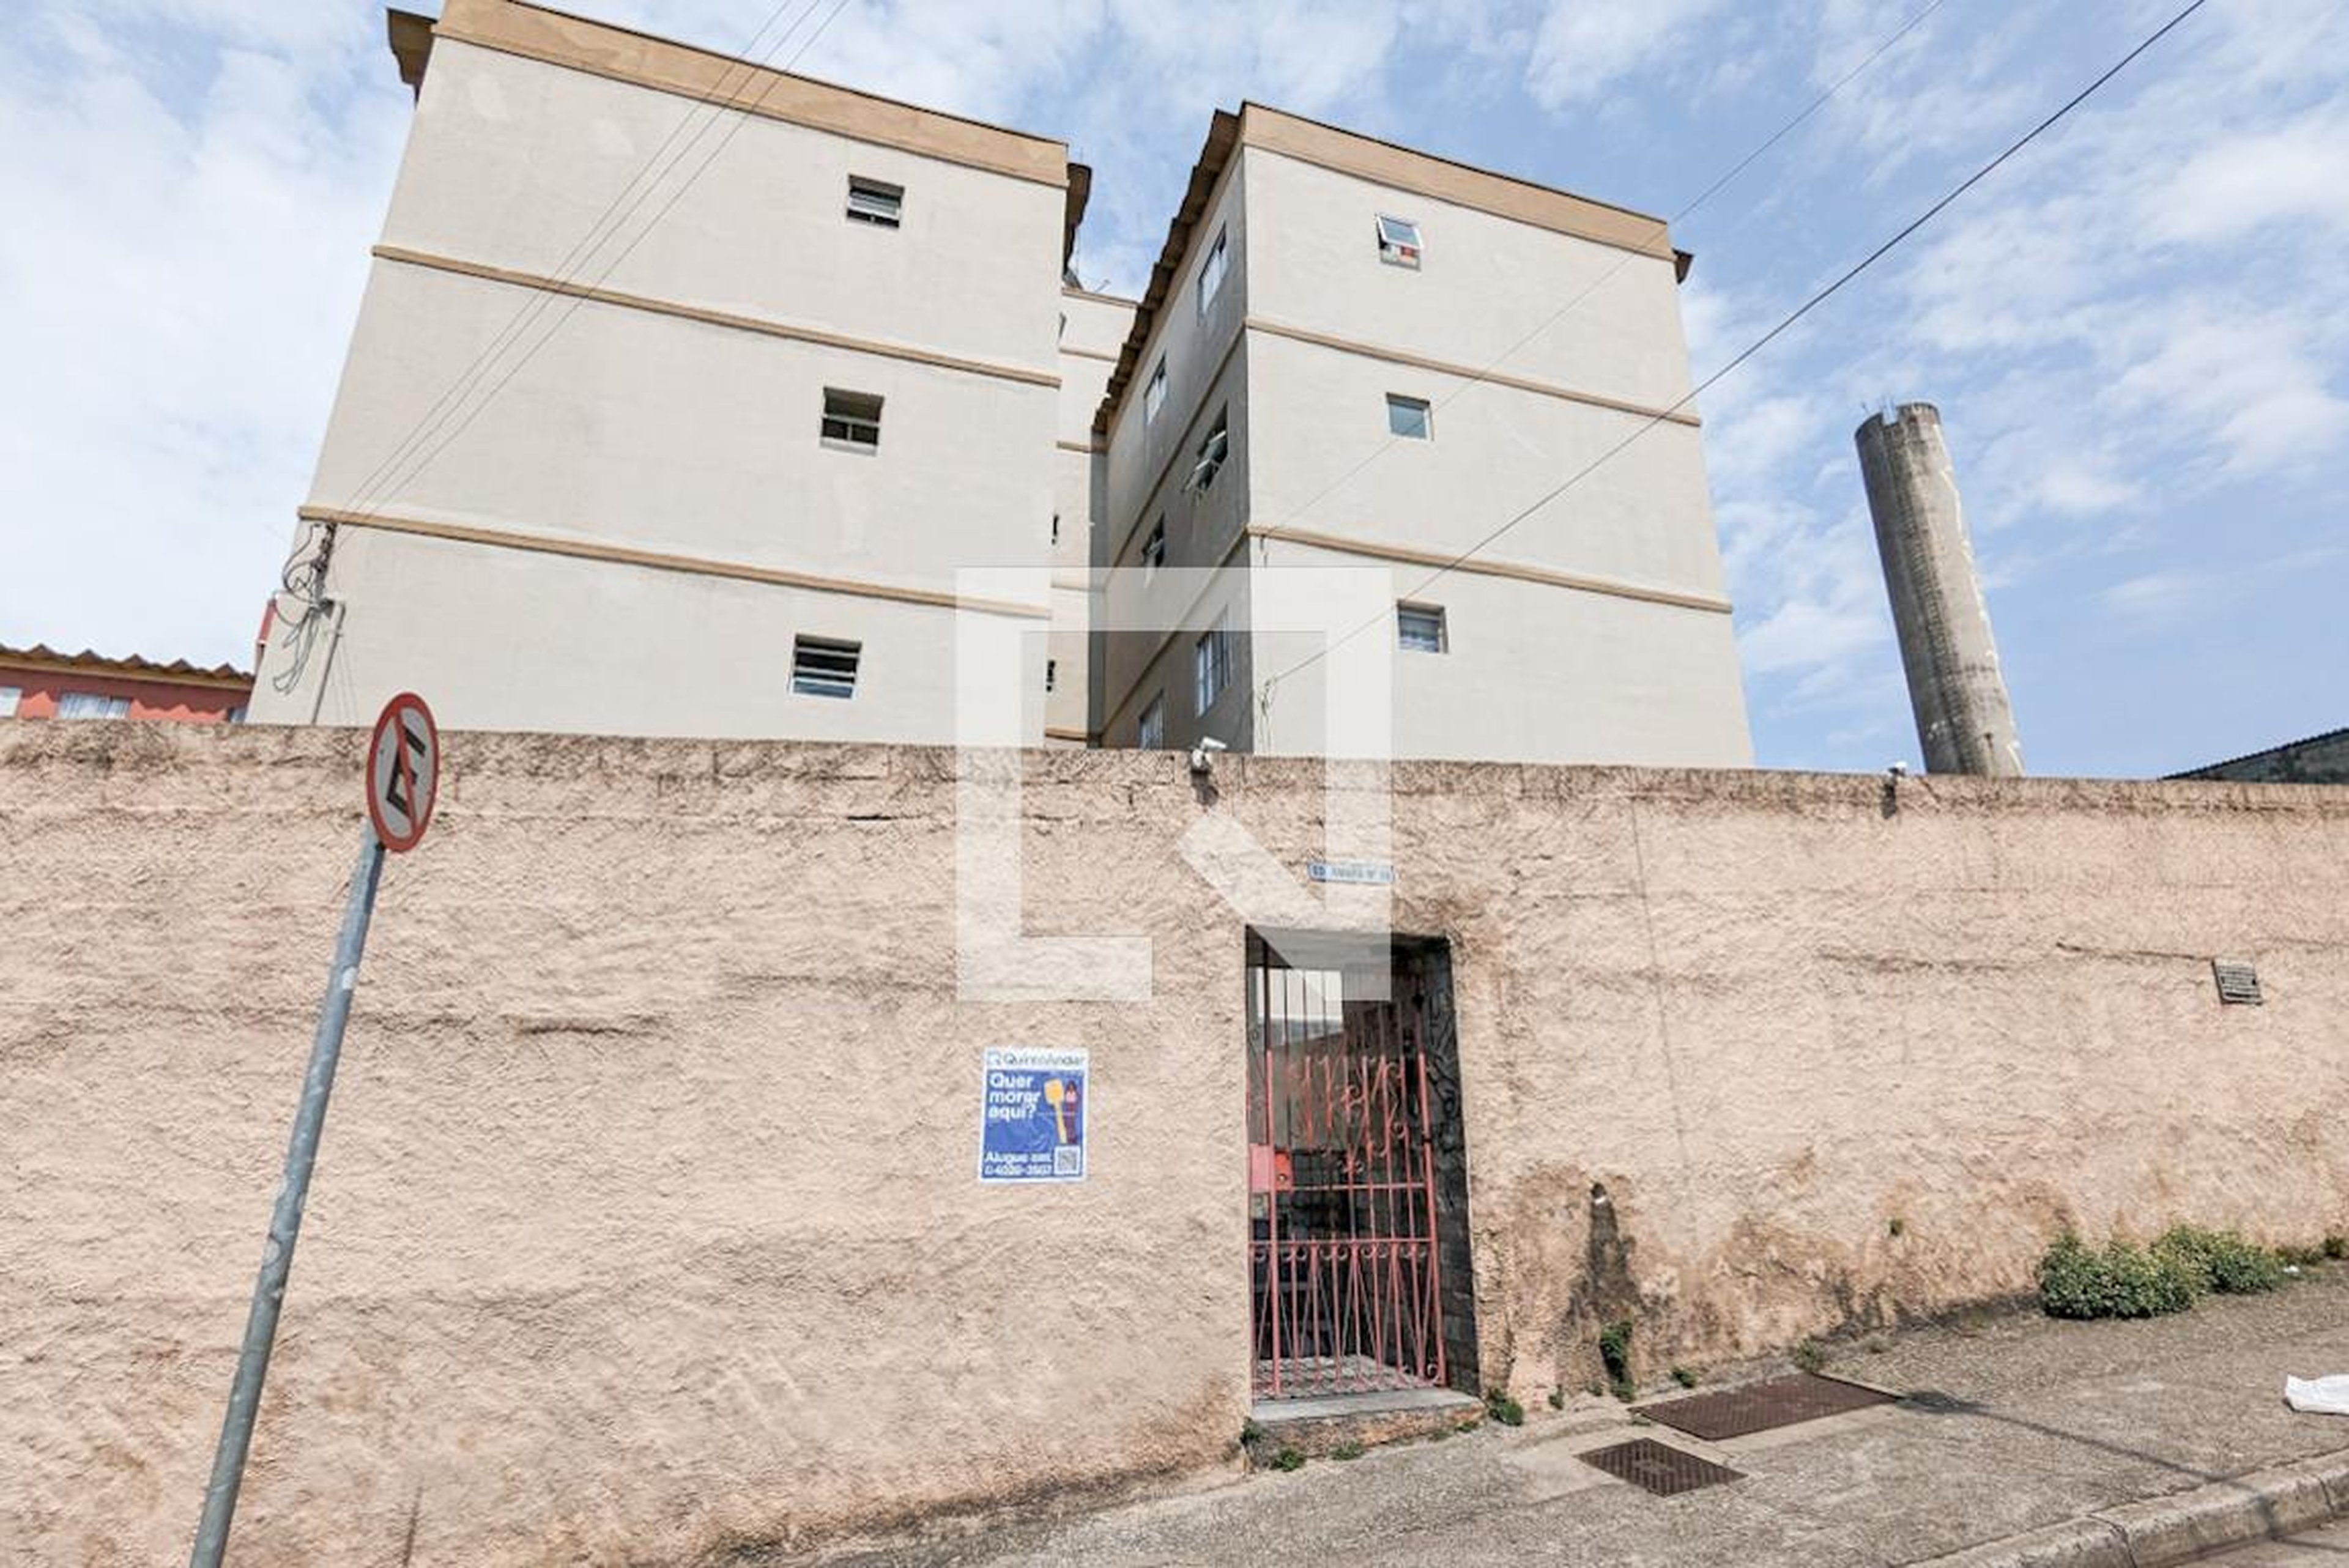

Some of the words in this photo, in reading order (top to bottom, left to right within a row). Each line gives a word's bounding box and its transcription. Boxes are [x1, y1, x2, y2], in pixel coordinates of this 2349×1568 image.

[989, 1073, 1034, 1089] Quer
[989, 1091, 1041, 1103] morar
[988, 1103, 1036, 1122] aqui?
